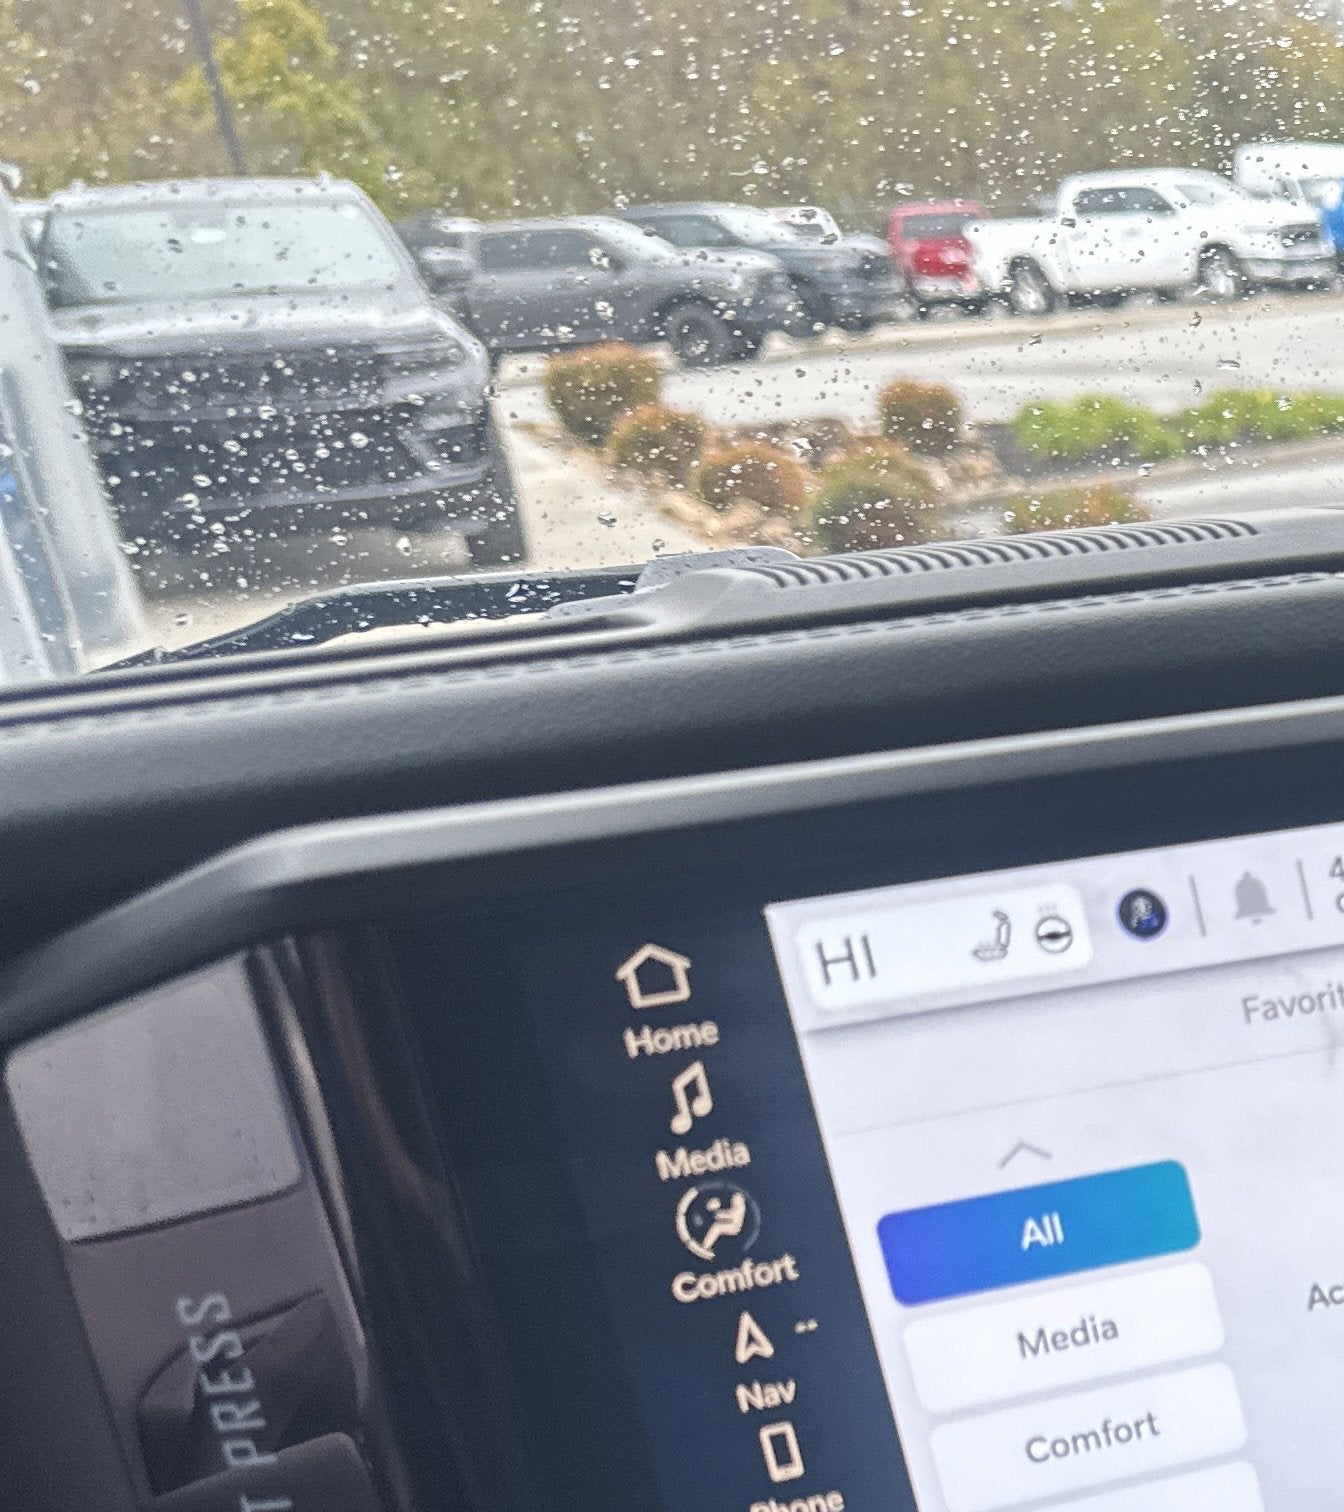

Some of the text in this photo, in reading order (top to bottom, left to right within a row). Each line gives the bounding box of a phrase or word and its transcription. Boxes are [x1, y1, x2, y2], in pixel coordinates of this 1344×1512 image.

[816, 934, 877, 985] HI
[624, 1020, 720, 1058] Home
[655, 1138, 752, 1182] Media
[1020, 1210, 1065, 1252] All
[672, 1253, 801, 1302] Comfort
[1016, 1314, 1120, 1361] Media
[175, 1293, 277, 1466] PRESS
[735, 1378, 797, 1414] Nav
[1024, 1410, 1161, 1464] Comfort
